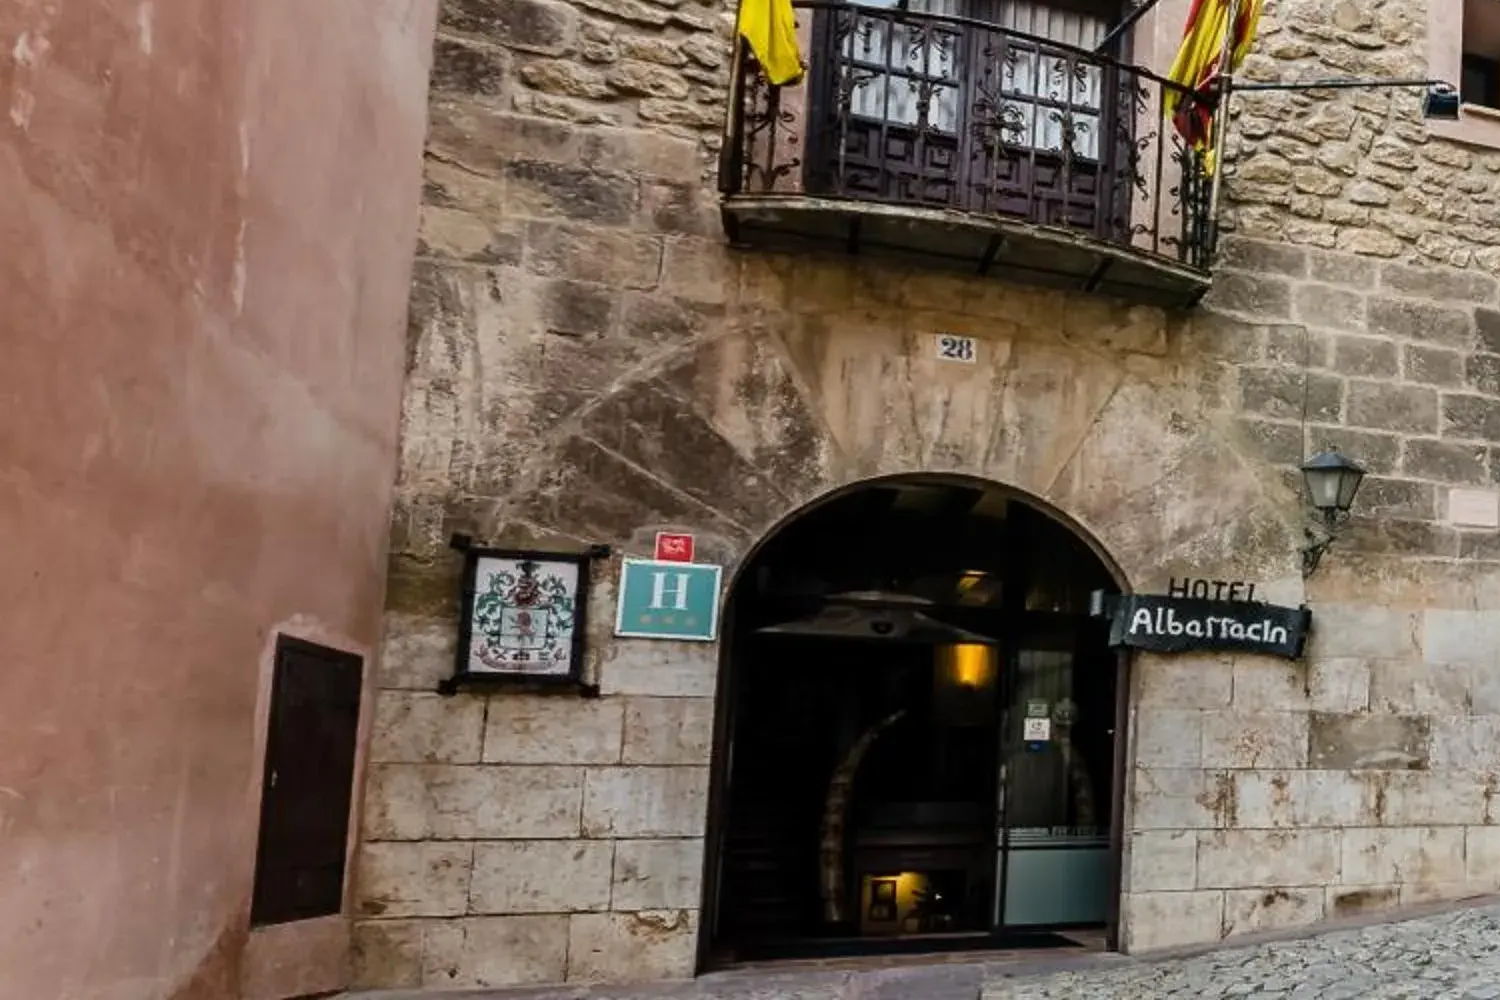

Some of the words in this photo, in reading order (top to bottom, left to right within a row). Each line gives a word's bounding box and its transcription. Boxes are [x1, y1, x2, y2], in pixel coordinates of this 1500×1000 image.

[942, 338, 973, 360] 28
[648, 571, 692, 611] H
[1168, 576, 1258, 602] HOTEL
